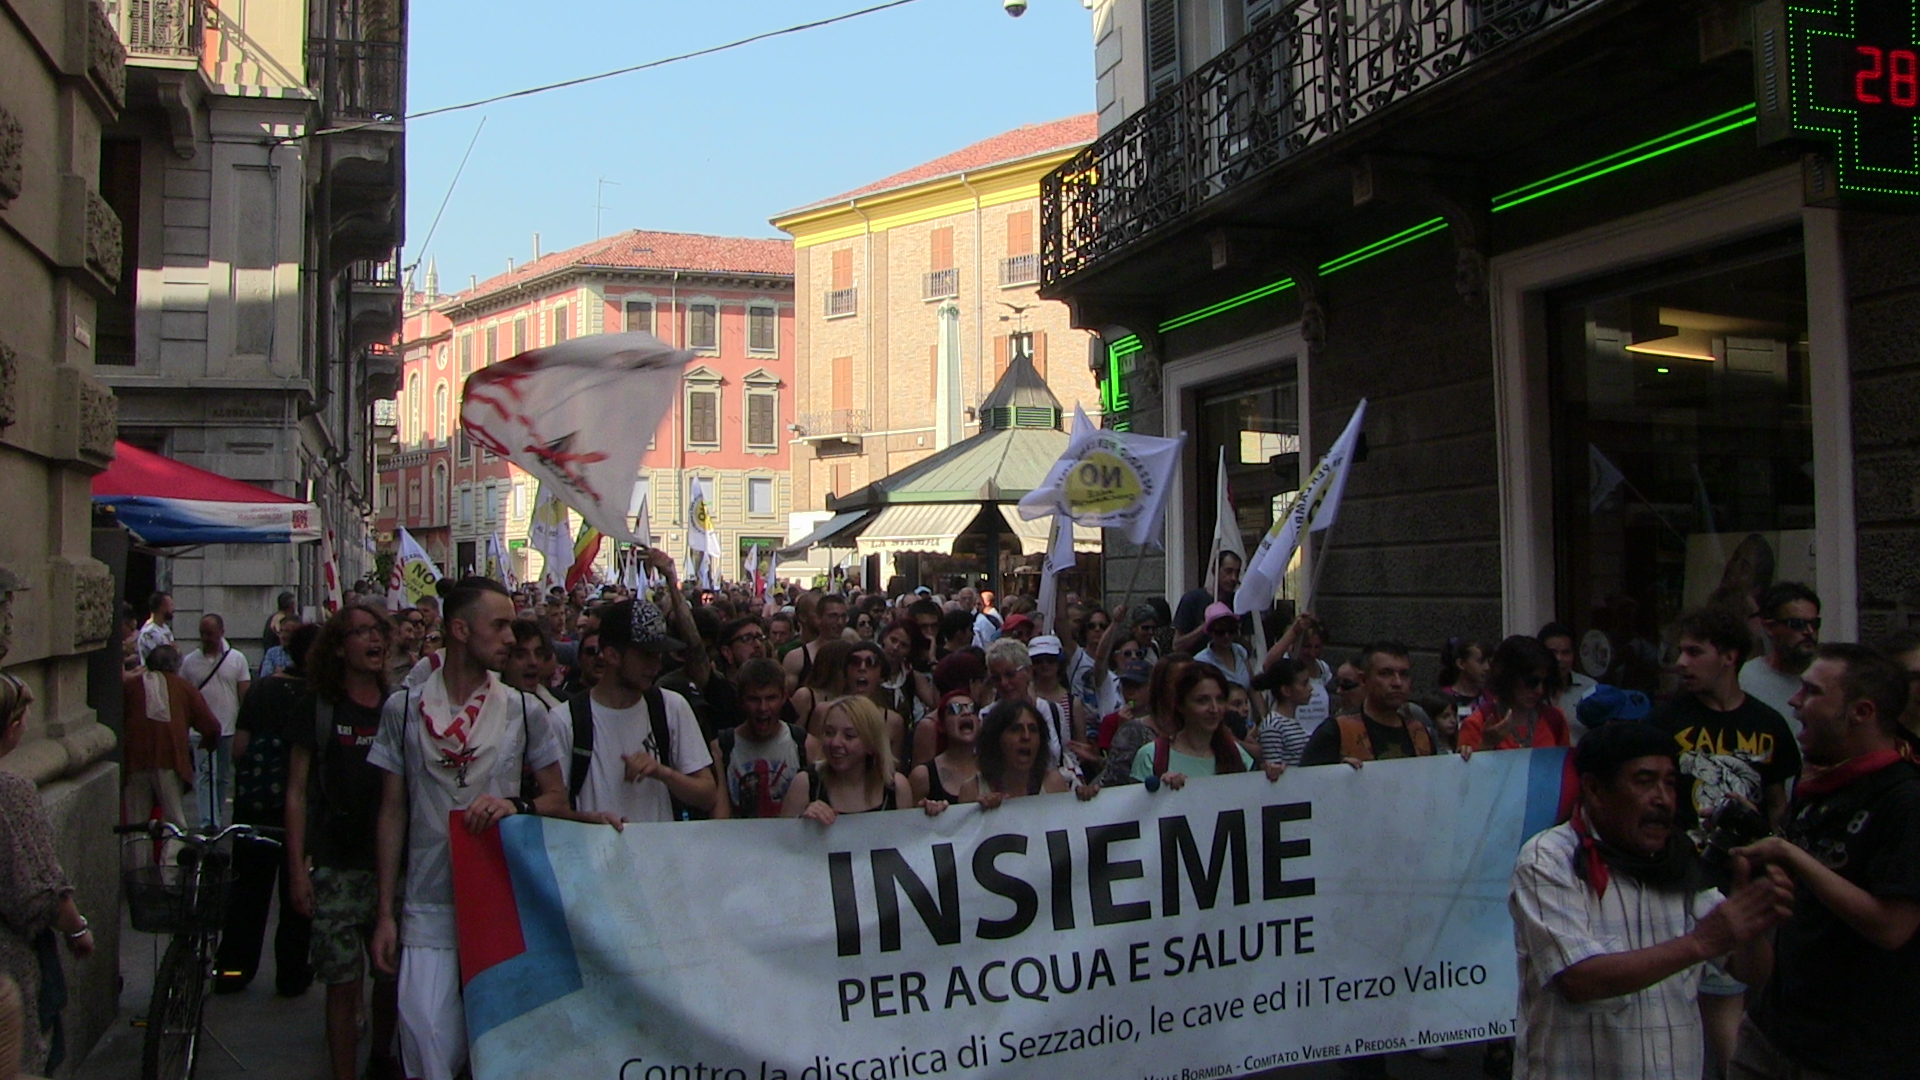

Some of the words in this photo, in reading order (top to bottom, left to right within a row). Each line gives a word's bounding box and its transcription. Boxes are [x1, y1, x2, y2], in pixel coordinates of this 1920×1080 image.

[1856, 46, 1916, 107] 28
[412, 563, 436, 585] NO
[1673, 725, 1774, 764] SALMO
[829, 801, 1316, 957] INSIEME
[838, 971, 931, 1022] PER
[944, 948, 1116, 1008] ACQUA
[1129, 941, 1151, 982] E
[1163, 916, 1315, 976] SALUTE
[801, 1046, 947, 1080] discarica
[957, 1035, 988, 1069] di
[1000, 1014, 1141, 1063] Sezzadio,
[1151, 1006, 1174, 1035] le
[1183, 996, 1244, 1028] cave
[1253, 982, 1286, 1014] ed
[1297, 979, 1310, 1008] il
[1319, 974, 1396, 1004] Terzo
[1404, 961, 1486, 993] Valico
[1302, 1044, 1341, 1059] VIVERE
[1355, 1037, 1407, 1053] PREDOSA
